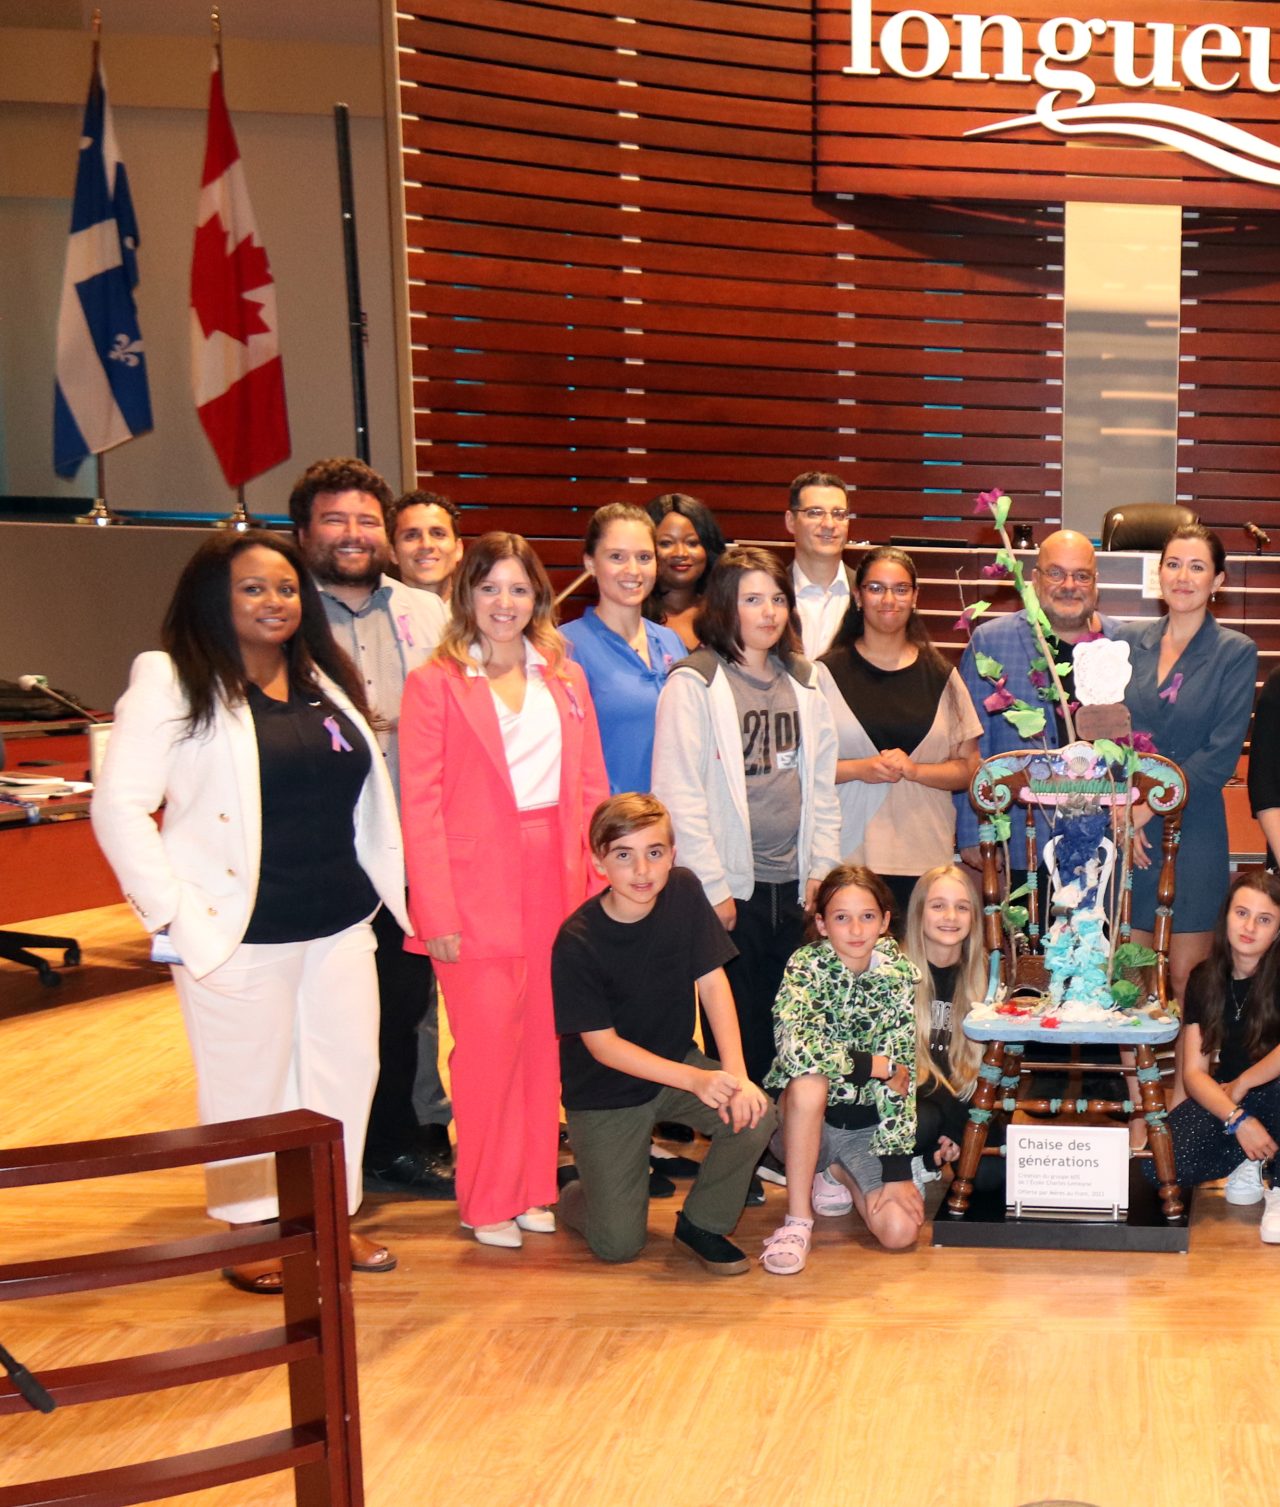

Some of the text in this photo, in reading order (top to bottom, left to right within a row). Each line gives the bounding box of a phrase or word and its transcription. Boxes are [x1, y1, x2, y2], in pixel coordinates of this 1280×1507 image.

[1018, 1137, 1091, 1151] Chaise des
[1018, 1154, 1100, 1168] générations
